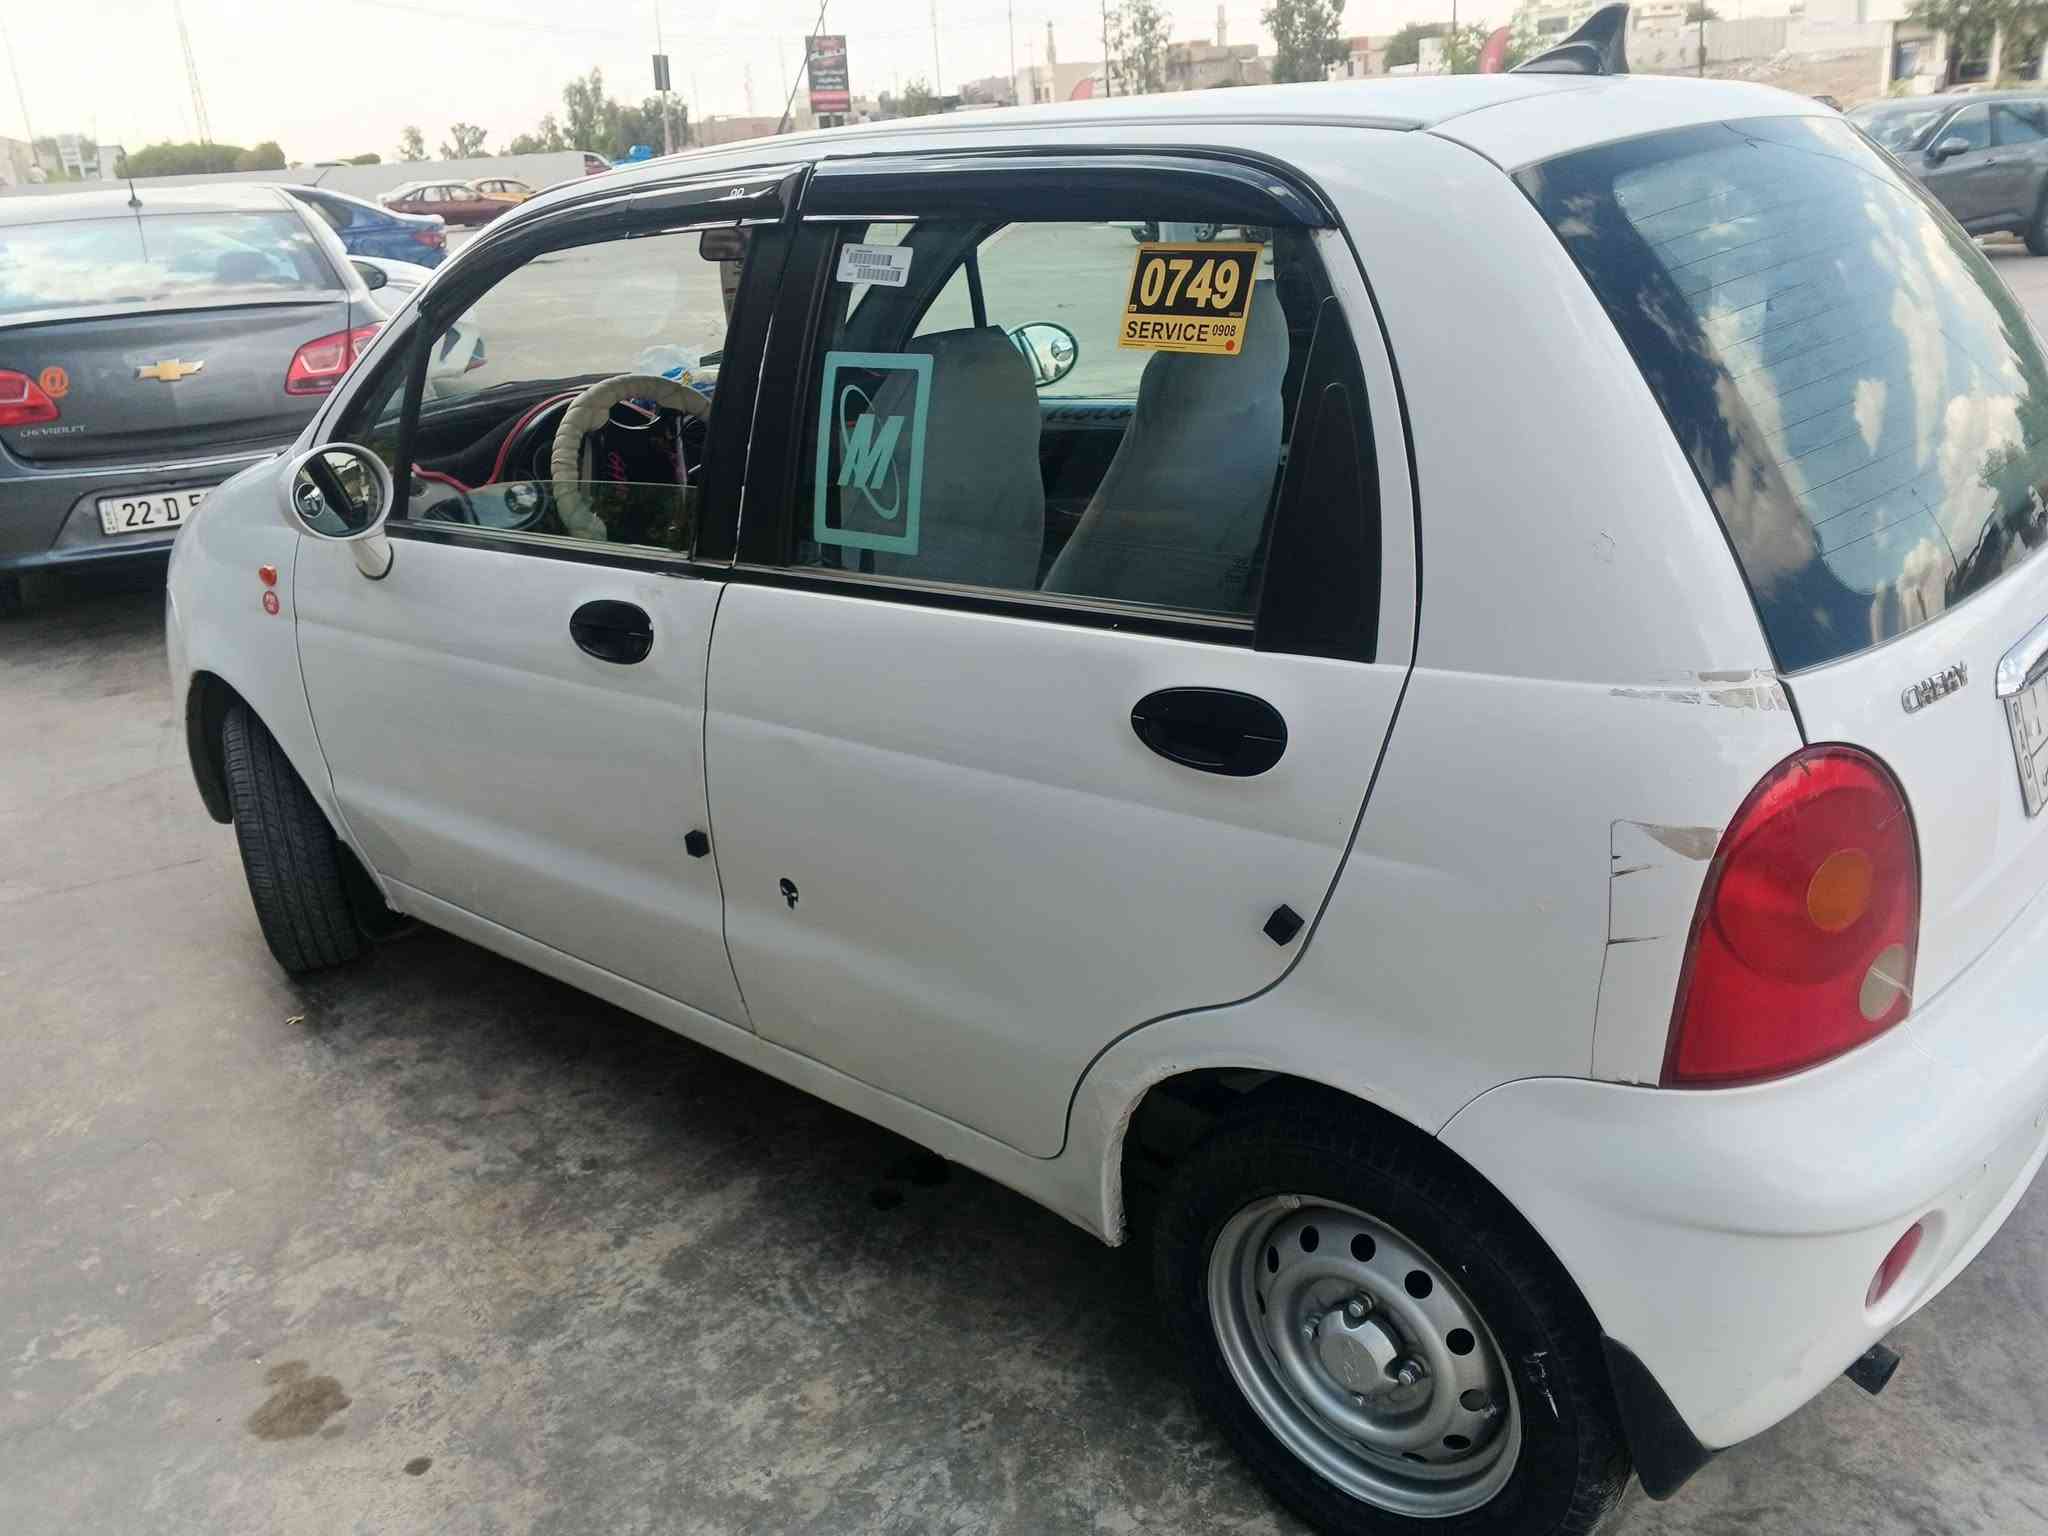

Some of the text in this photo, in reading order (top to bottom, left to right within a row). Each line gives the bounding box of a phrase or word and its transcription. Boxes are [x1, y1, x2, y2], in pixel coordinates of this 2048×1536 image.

[1140, 257, 1240, 309] 0749
[1126, 320, 1236, 342] SERVICE 0908
[122, 501, 155, 526] 22
[163, 497, 180, 521] D
